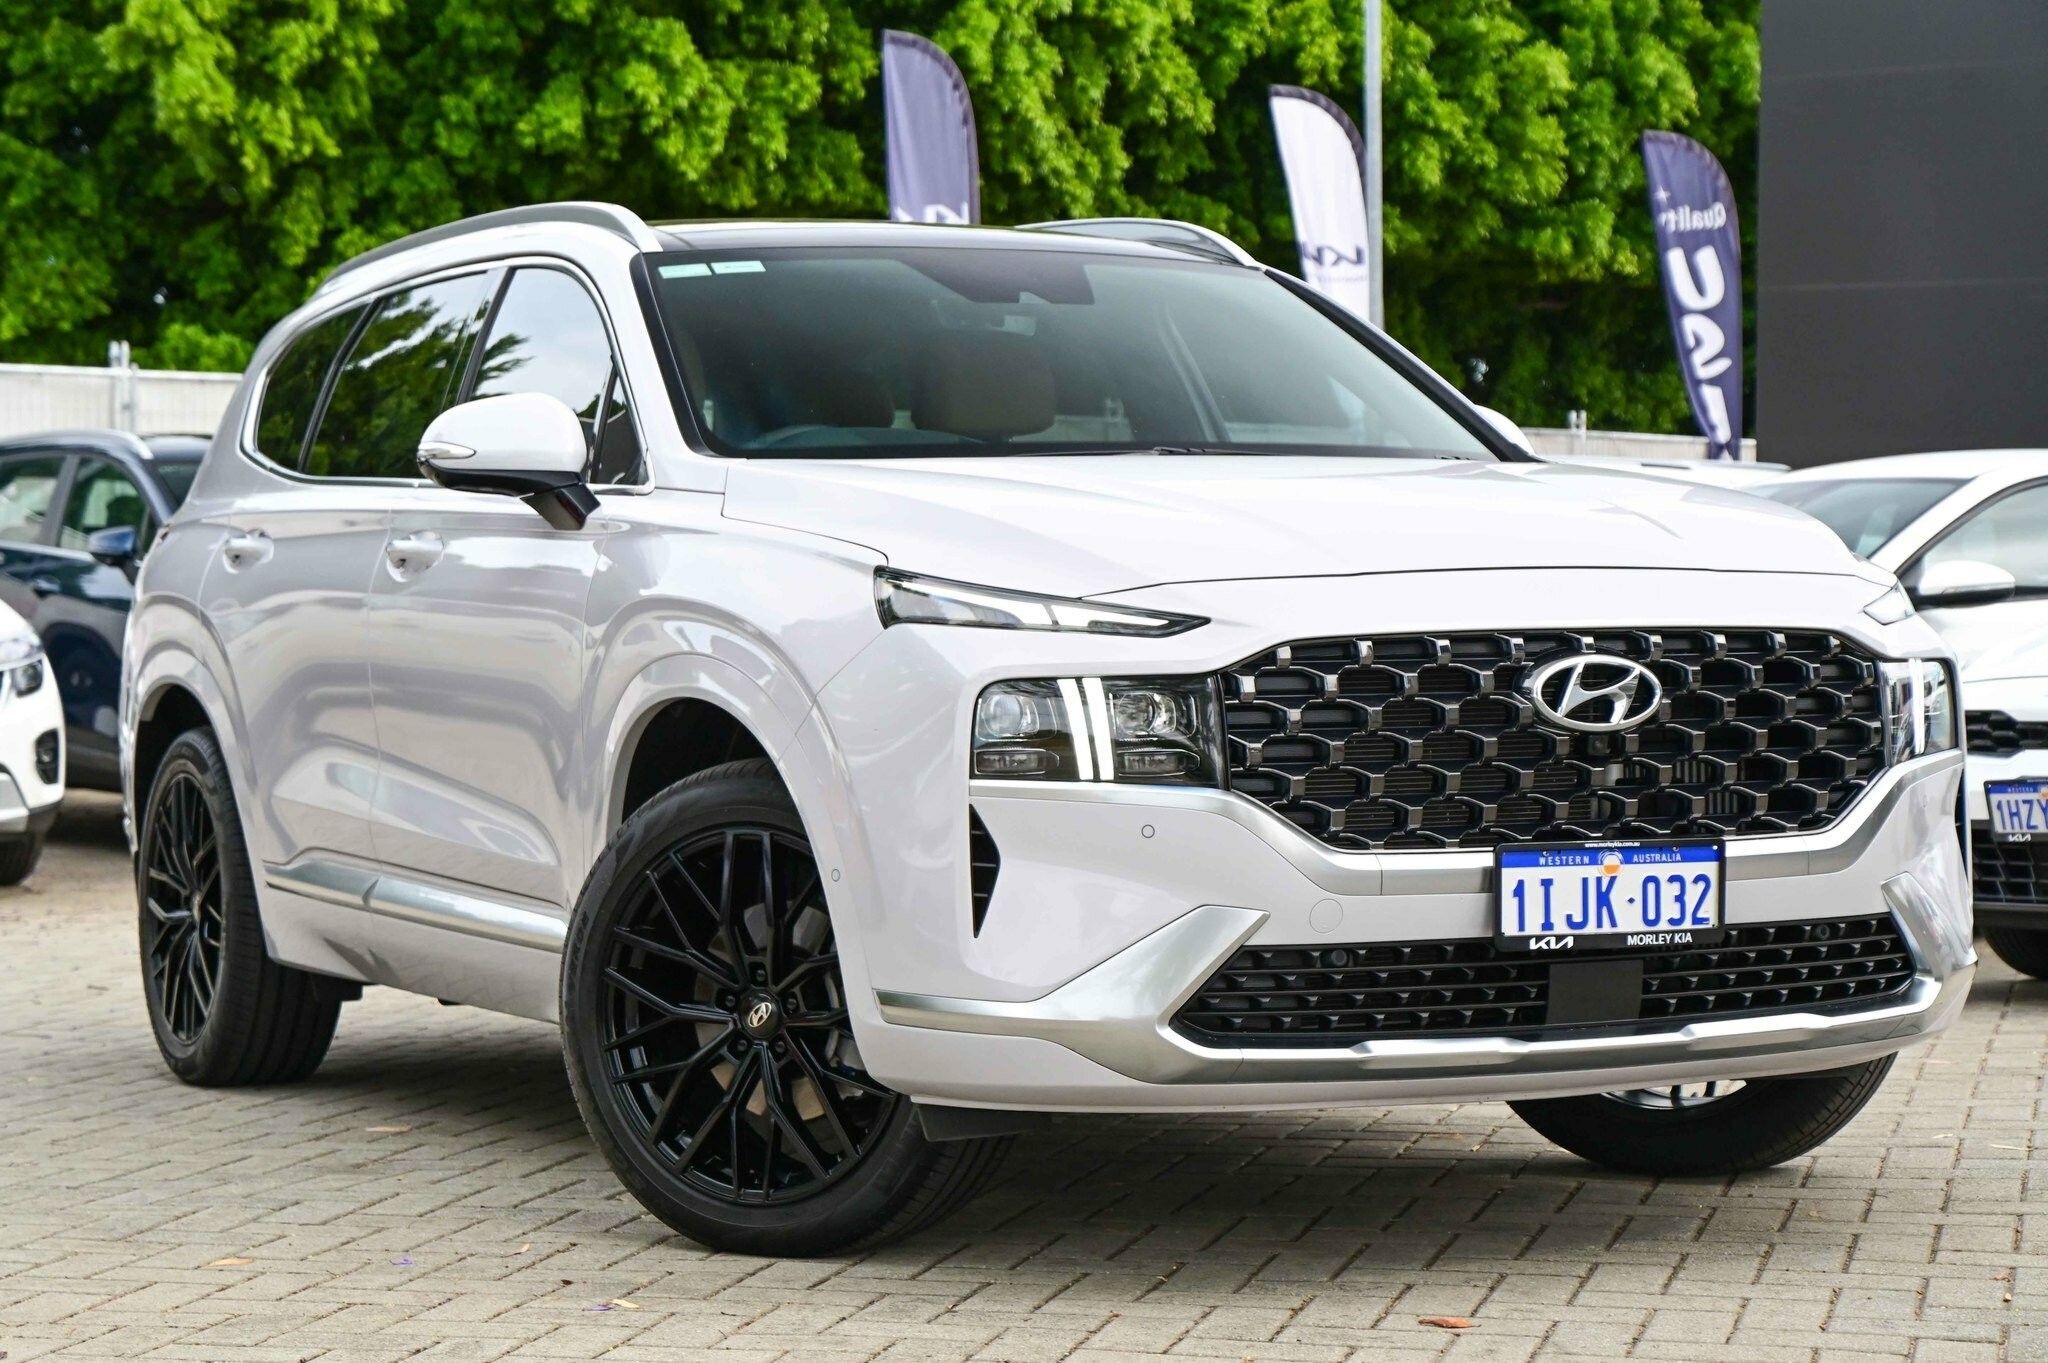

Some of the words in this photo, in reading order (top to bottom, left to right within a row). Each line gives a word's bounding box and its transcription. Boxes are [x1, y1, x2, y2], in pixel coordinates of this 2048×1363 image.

[1539, 855, 1590, 866] WESTERN
[1632, 853, 1682, 863] AUSTRALIA
[1529, 936, 1574, 950] KIA
[1627, 934, 1673, 946] MORLEY
[1674, 932, 1693, 944] KIA
